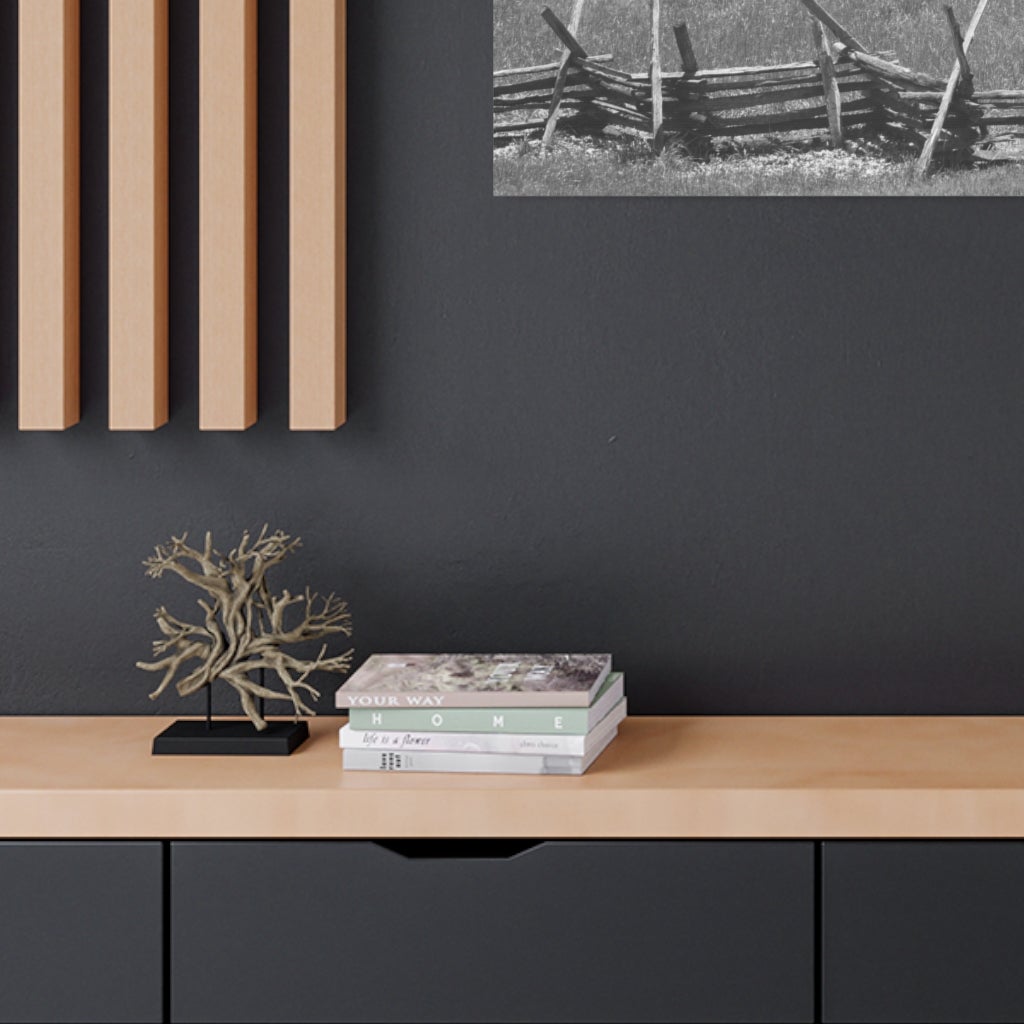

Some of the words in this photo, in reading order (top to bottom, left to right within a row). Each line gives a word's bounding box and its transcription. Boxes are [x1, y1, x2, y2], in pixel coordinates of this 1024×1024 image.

[347, 695, 399, 706] YOUR
[406, 695, 445, 706] WAY
[371, 712, 563, 730] HOME
[400, 733, 431, 749] flower
